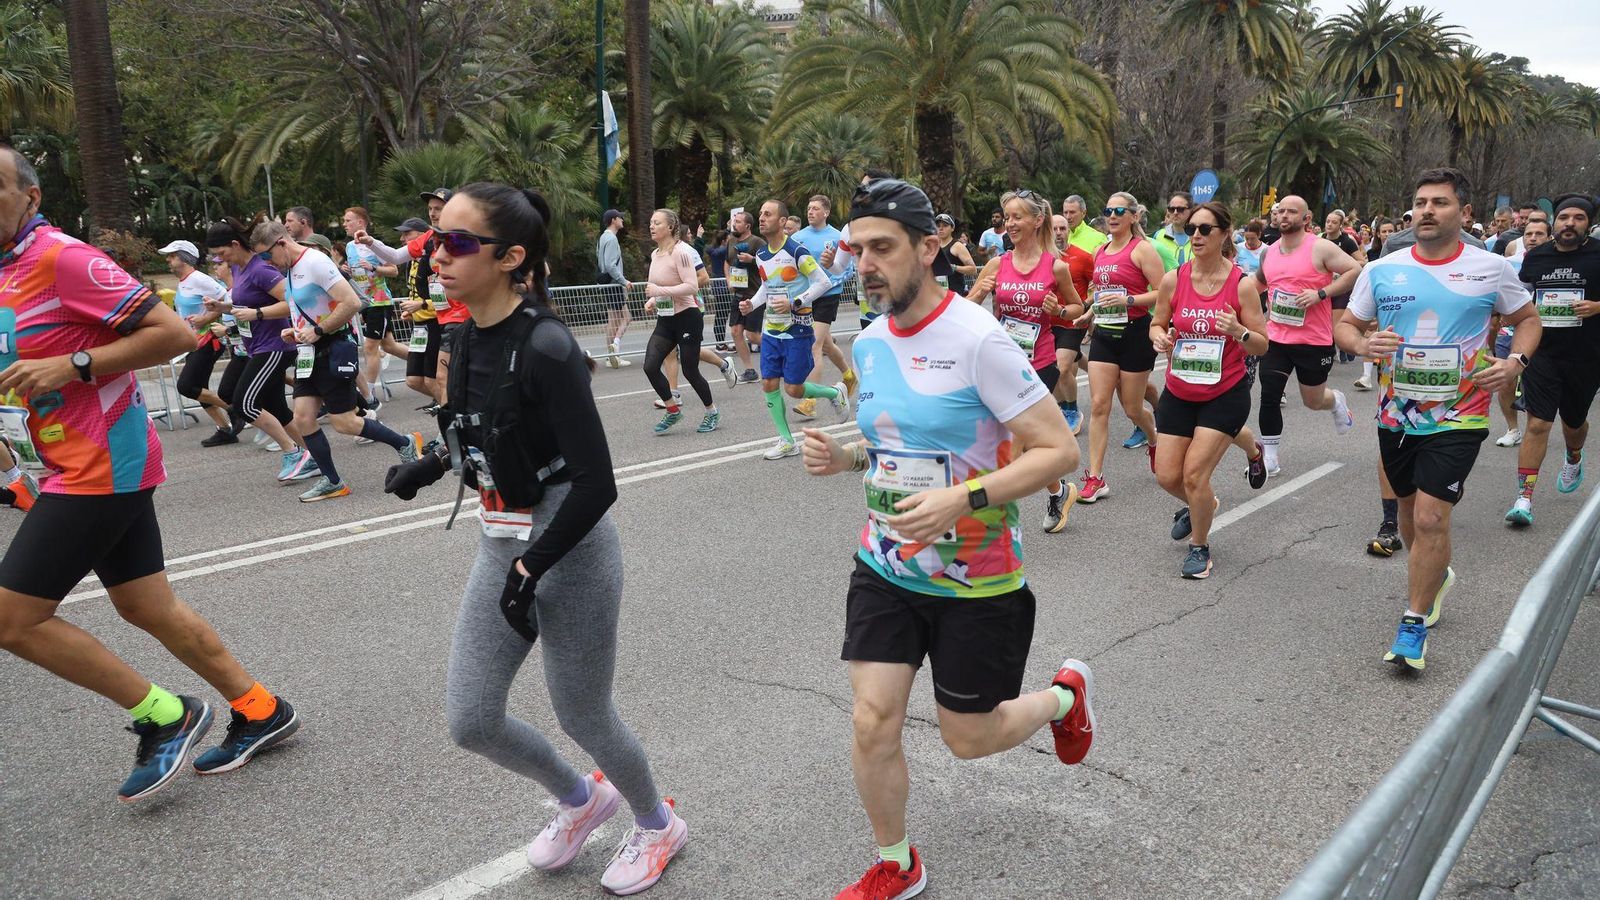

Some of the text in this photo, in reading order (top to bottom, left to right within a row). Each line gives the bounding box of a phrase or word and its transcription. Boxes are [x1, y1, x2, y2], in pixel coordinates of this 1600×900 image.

[1094, 264, 1119, 273] ANGIE
[1541, 272, 1581, 281] MASTER
[1001, 282, 1045, 292] MAXINE
[1379, 295, 1416, 304] Málaga
[1545, 306, 1575, 317] 4525
[1194, 321, 1207, 332] ft
[1181, 359, 1213, 373] 6179
[1407, 371, 1450, 386] 6362
